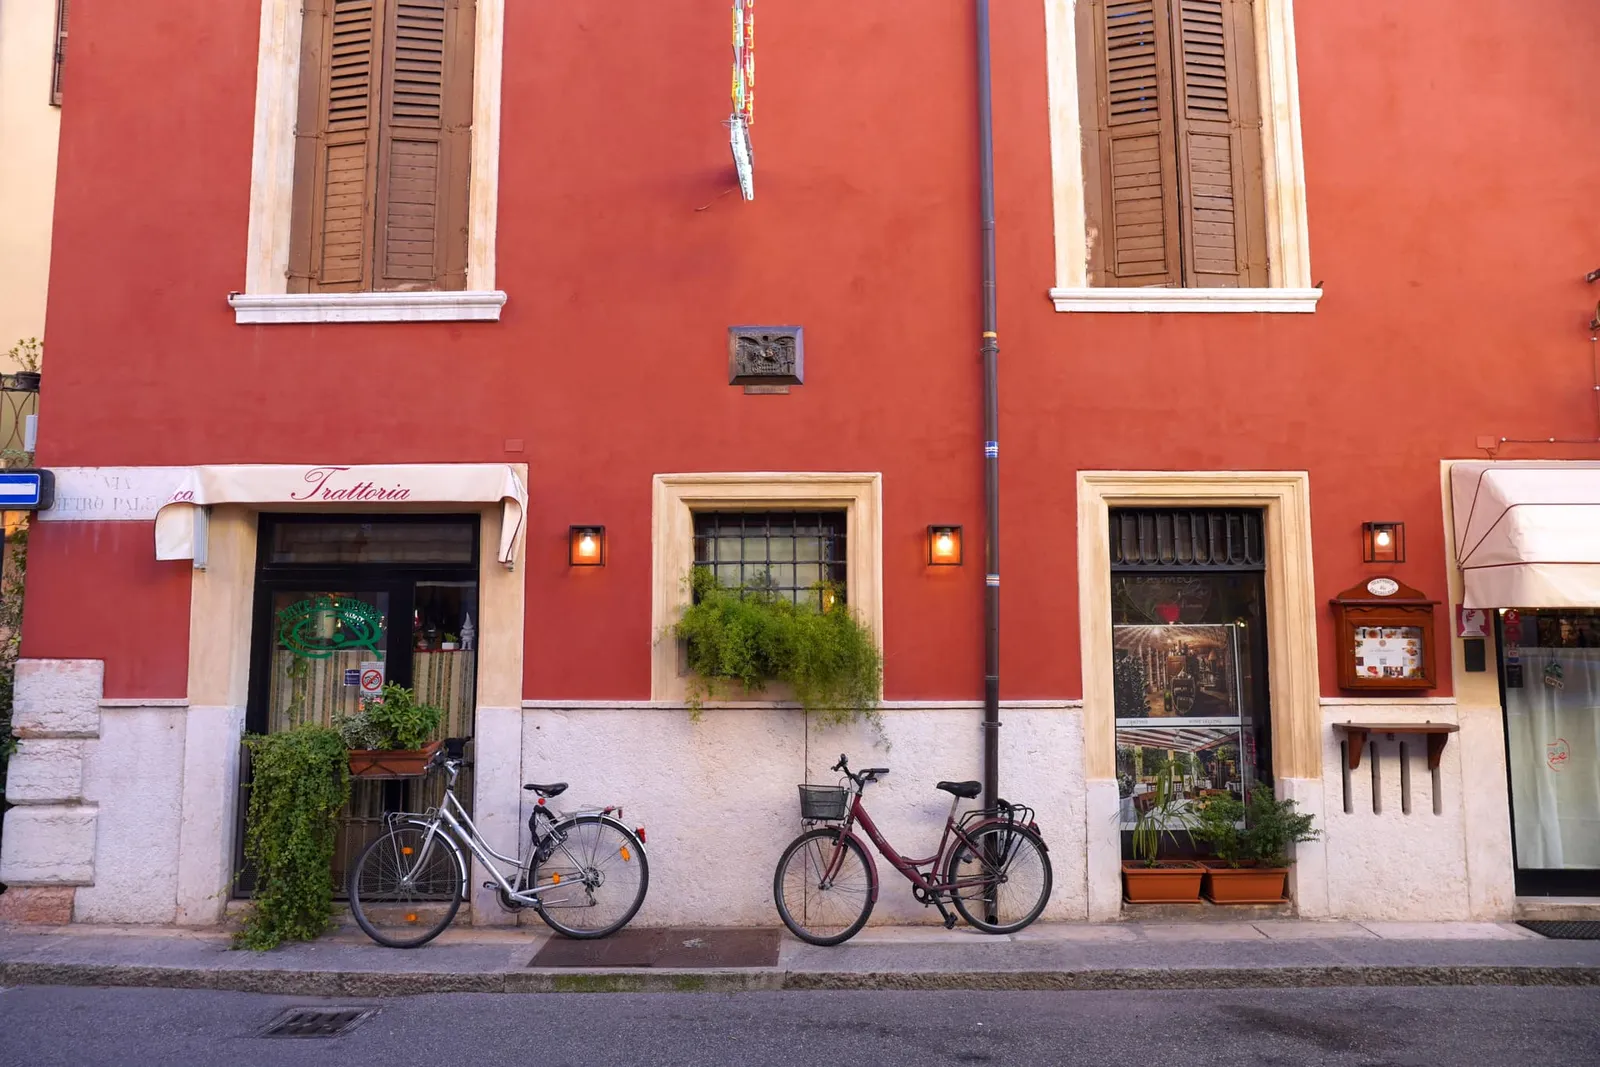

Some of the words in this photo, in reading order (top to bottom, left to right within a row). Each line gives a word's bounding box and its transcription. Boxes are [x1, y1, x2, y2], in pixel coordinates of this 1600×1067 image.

[102, 476, 132, 490] VIA
[290, 467, 410, 500] Trattoria
[56, 496, 104, 511] IETRO
